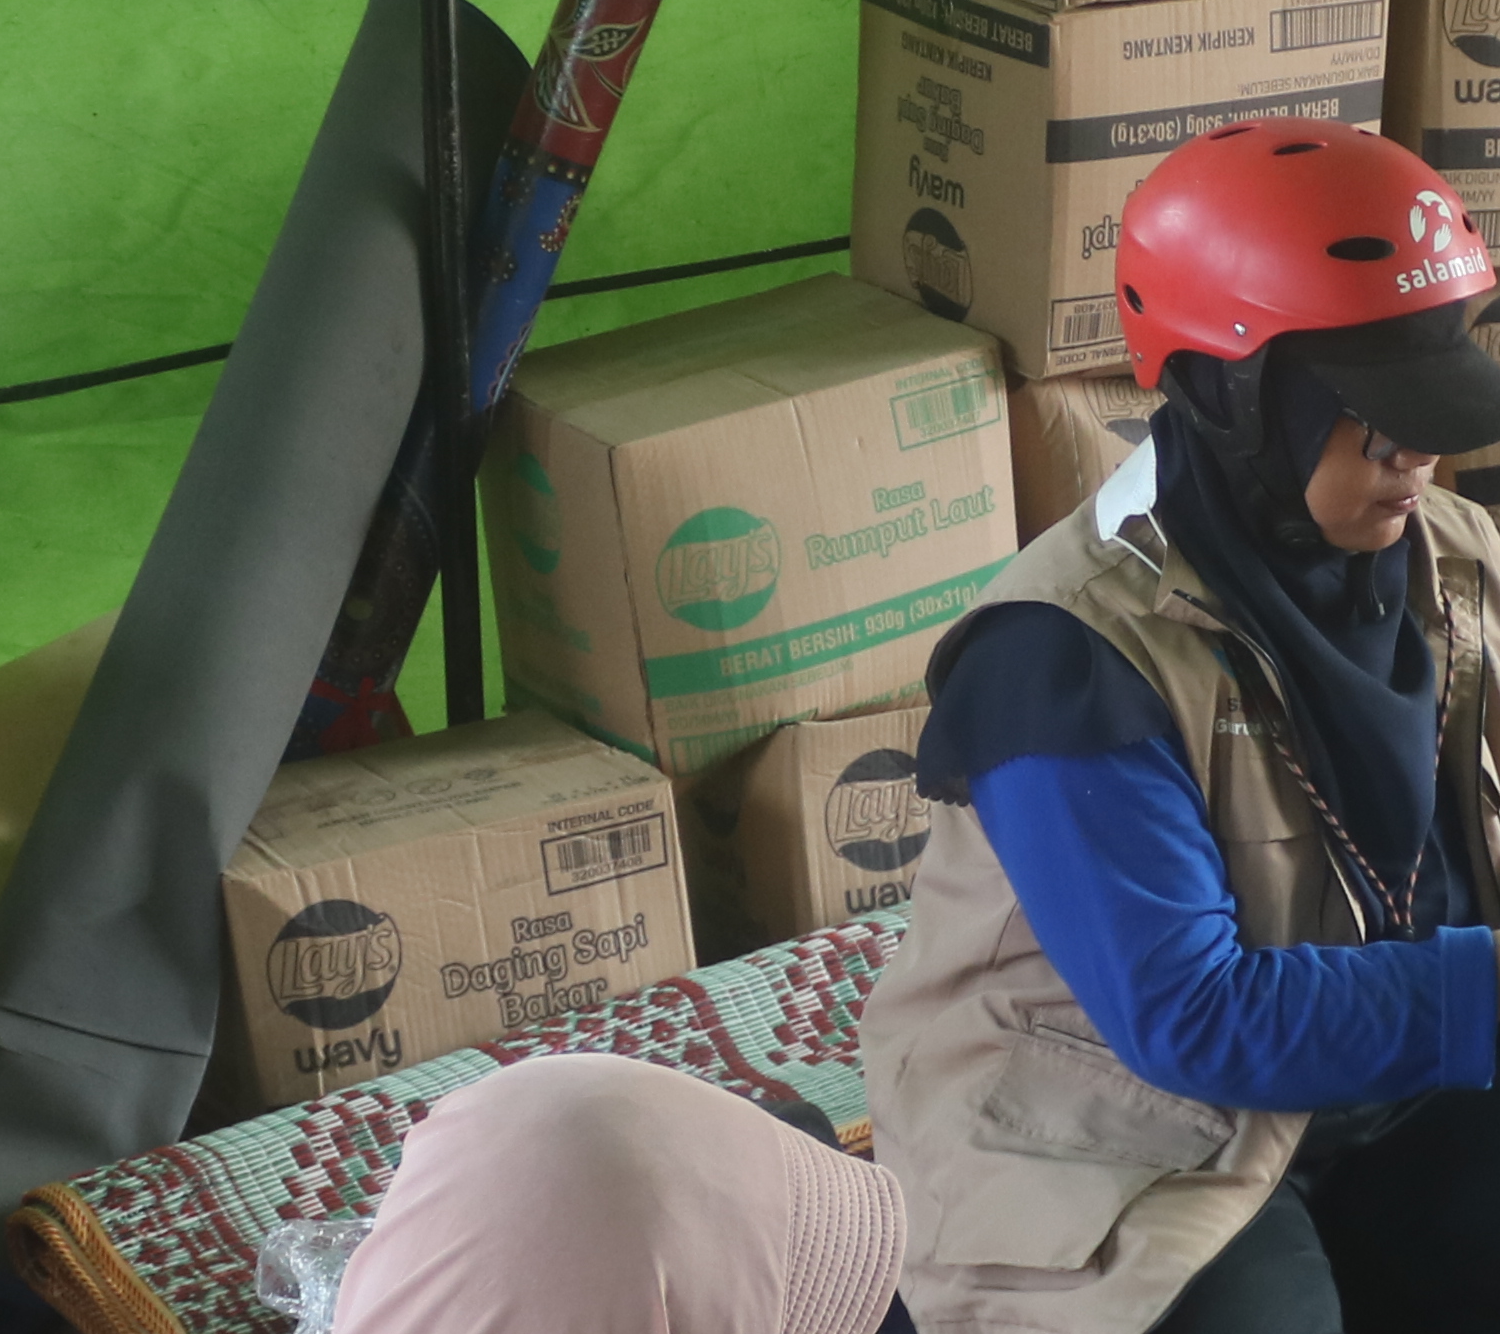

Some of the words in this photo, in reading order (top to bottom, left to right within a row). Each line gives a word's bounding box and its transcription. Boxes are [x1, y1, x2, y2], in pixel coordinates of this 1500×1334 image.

[1122, 35, 1193, 60] KENTANG
[1198, 27, 1255, 50] KERIPIK
[1111, 123, 1180, 147] (30x31g)
[1396, 248, 1487, 294] salamaid
[873, 481, 925, 512] Rasa
[805, 508, 927, 569] Rumput
[930, 484, 995, 530] Laut
[720, 644, 783, 676] BERAT
[789, 622, 860, 660] BERSIH:
[865, 609, 904, 637] 930g
[909, 582, 977, 625] (30x31g)
[547, 809, 613, 833] INTERNAL
[618, 799, 654, 818] CODE
[512, 912, 572, 943] Rasa
[280, 925, 392, 1001] Lay's
[441, 942, 568, 999] Daging
[571, 914, 649, 966] Sapi
[500, 977, 607, 1027] Bakar
[294, 1029, 402, 1074] wavy
